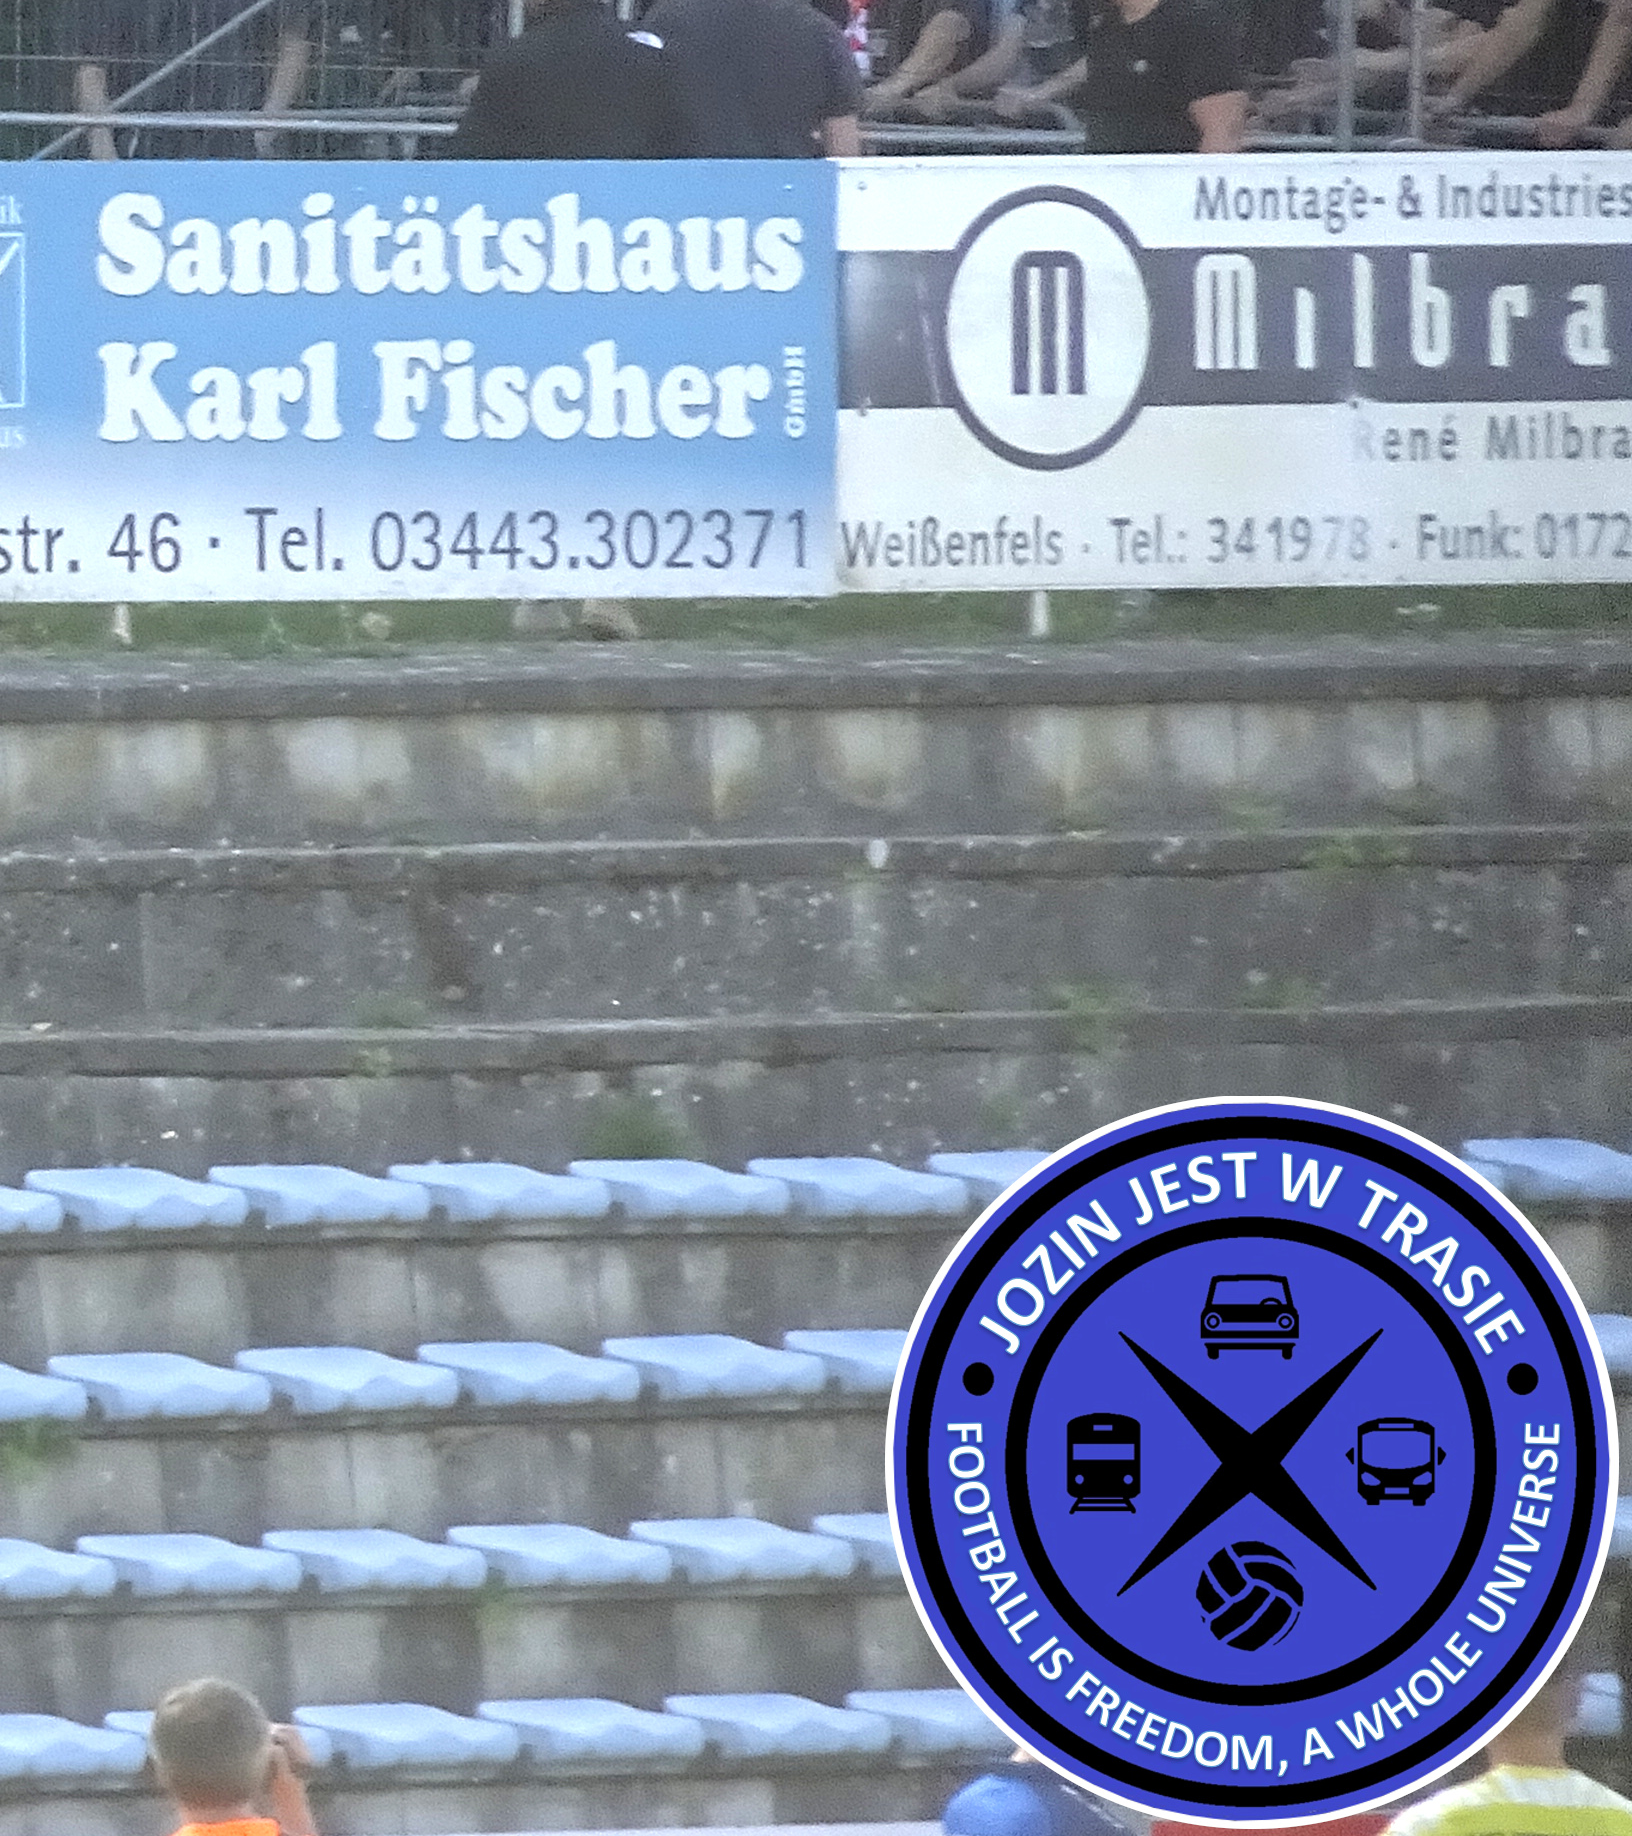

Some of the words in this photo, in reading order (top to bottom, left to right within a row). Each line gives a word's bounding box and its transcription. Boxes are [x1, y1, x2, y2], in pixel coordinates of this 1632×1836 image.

[1193, 176, 1386, 235] Montage-
[1397, 174, 1423, 219] &
[1437, 169, 1632, 219] Industries
[95, 191, 806, 296] Sanitätshaus
[1193, 250, 1614, 371] Milbra
[96, 338, 343, 443] Karl
[372, 337, 772, 443] Fischer
[783, 344, 807, 440] GmbH
[1353, 413, 1457, 462] René
[1486, 411, 1632, 461] Milbra
[107, 511, 182, 573] 46
[245, 506, 343, 573] Tel.
[370, 507, 809, 574] 03443.302371
[839, 513, 1064, 568] Weißenfels
[1109, 513, 1188, 565] Tel.:
[1206, 515, 1372, 565] 341978
[1417, 510, 1522, 561] Funk:
[1536, 510, 1632, 560] 0172
